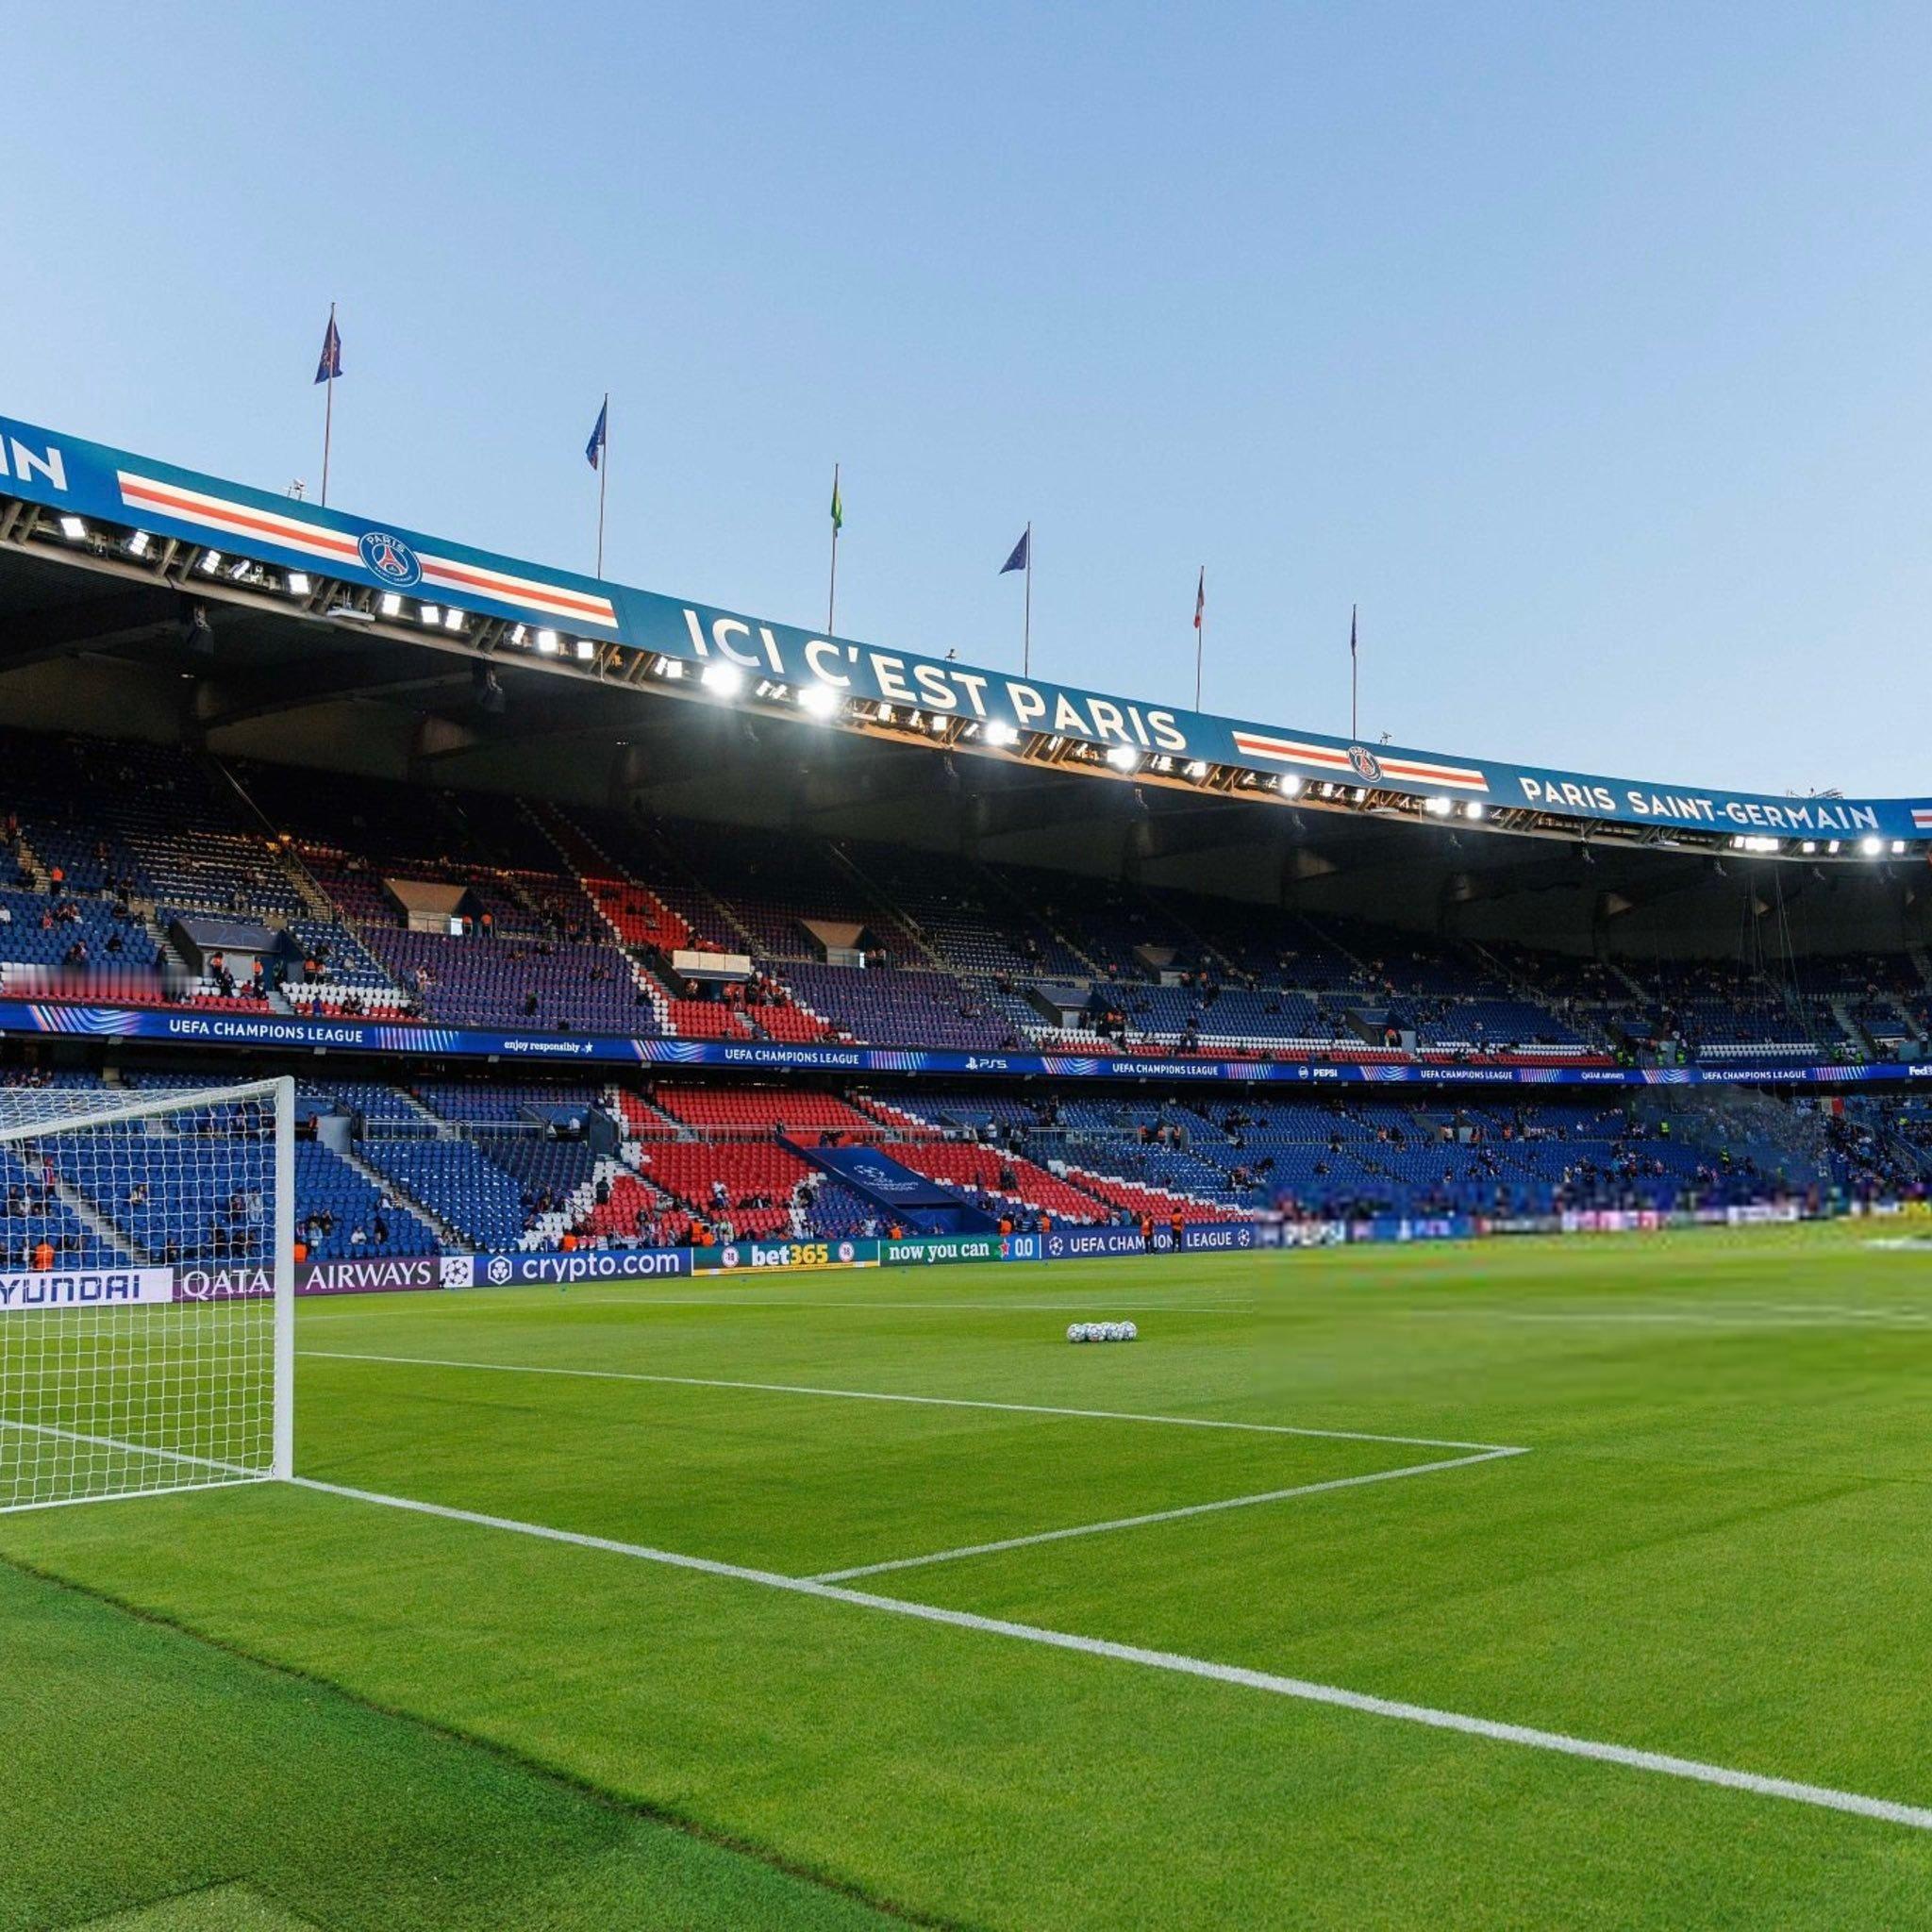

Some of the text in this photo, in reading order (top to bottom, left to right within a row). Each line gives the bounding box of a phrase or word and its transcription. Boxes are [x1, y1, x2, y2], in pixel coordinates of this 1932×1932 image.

[366, 534, 406, 553] PARIS
[683, 608, 1187, 751] ICI C'EST PARIS
[1519, 777, 1879, 830] PARIS SAINT-GERMAIN
[169, 1019, 363, 1042] UEFA CHAMPIONS LEAGUE
[504, 1039, 580, 1053] enjoy responsibly
[724, 1048, 859, 1064] UEFA CHAMPIONS LEAGUE
[979, 1058, 1008, 1069] PS5
[1112, 1063, 1219, 1075] UEFA CHAMPIONS LEAGUE
[1313, 1068, 1338, 1077] PEPSI
[1421, 1070, 1513, 1080] UEFA CHAMPIONS LEAGUE
[1702, 1070, 1807, 1080] UEFA CHAMPIONS LEAGUE
[889, 1241, 990, 1263] now you can
[1070, 1231, 1233, 1253] UEFA CHAMION LEAGUE
[752, 1243, 829, 1267] bet365
[523, 1252, 680, 1283] crypto.com
[183, 1261, 431, 1301] QATA AIRWAYS
